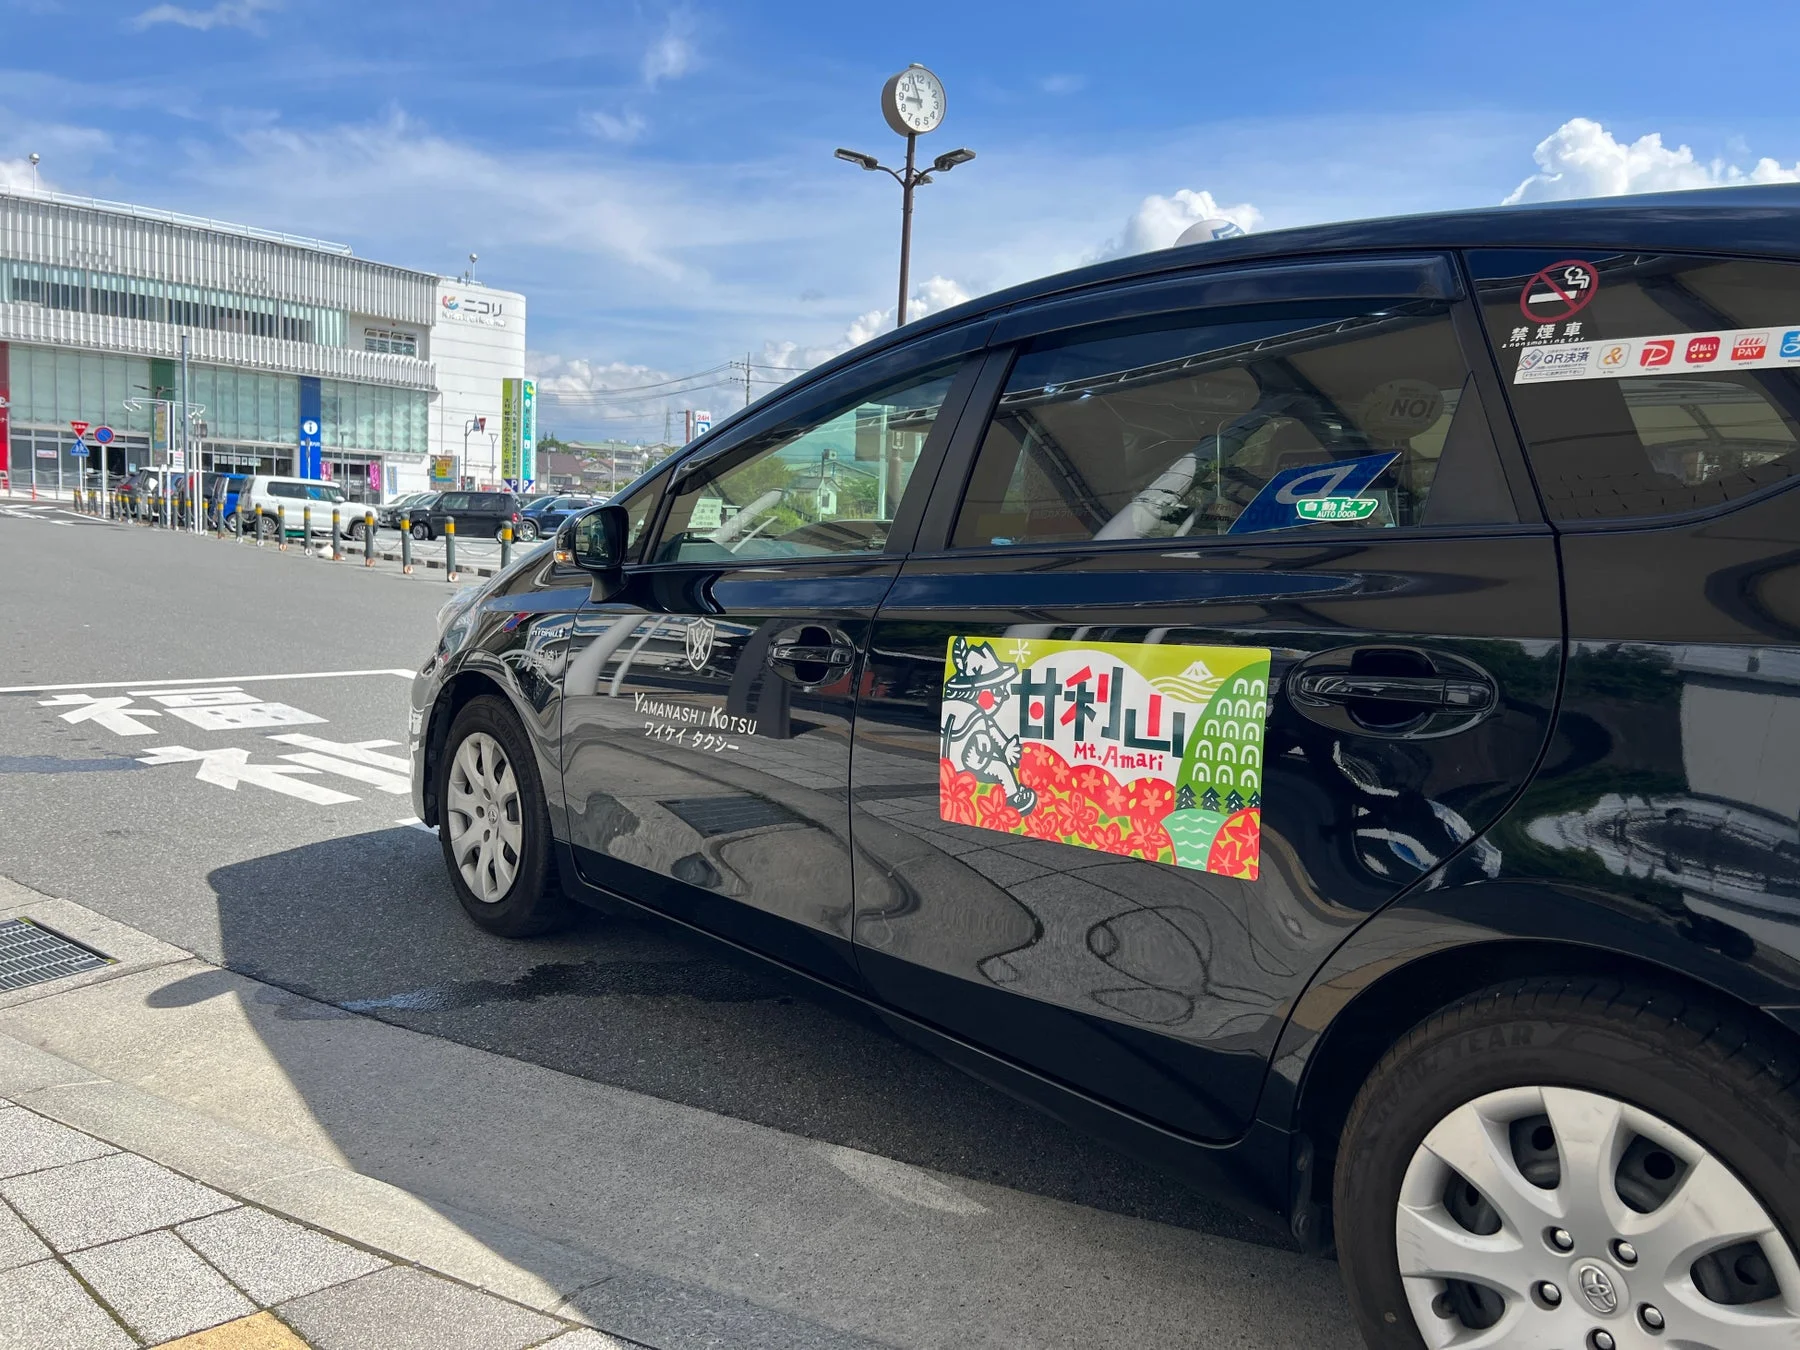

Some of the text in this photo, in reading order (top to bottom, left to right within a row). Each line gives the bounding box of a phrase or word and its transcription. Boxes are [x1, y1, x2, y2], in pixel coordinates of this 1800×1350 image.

[916, 75, 925, 84] 12
[901, 83, 910, 92] 10
[898, 92, 905, 101] 9
[931, 90, 938, 98] 2
[900, 103, 907, 112] 8
[933, 101, 939, 110] 3
[907, 113, 914, 121] 7
[929, 111, 935, 120] 4
[915, 117, 921, 127] 6
[923, 117, 929, 125] 5
[463, 299, 503, 318] ニコリ
[1510, 321, 1583, 342] 禁煙車
[1737, 347, 1759, 357] PAY
[1543, 351, 1590, 365] QR決済
[1304, 501, 1374, 511] 自動ドア
[1317, 509, 1357, 519] AUTO DOOR
[1010, 665, 1186, 759] 甘利山
[709, 706, 758, 735] KOTSU
[644, 721, 740, 753] ワイケイ タクシー
